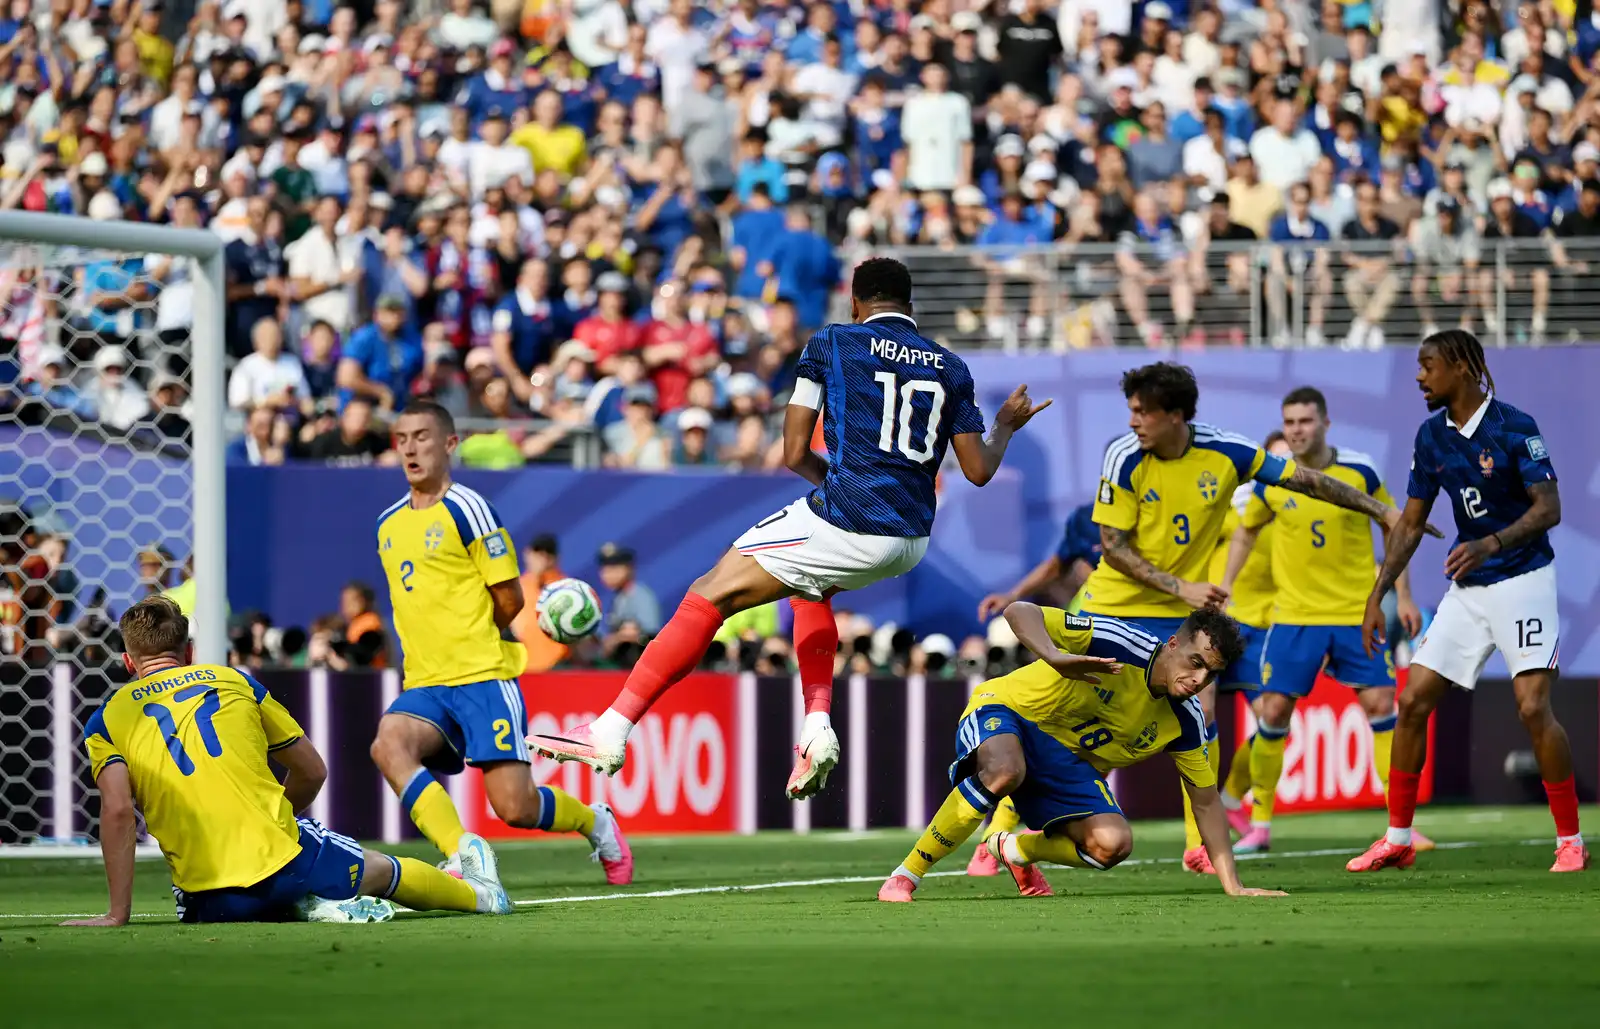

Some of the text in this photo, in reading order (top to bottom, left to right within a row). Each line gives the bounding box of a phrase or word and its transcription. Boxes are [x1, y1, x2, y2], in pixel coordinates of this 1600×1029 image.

[870, 337, 944, 369] MBAPPE
[874, 371, 947, 464] 10
[1460, 486, 1488, 519] 12
[1172, 513, 1190, 545] 3
[1311, 520, 1326, 549] 5
[400, 560, 414, 592] 2
[1515, 618, 1543, 648] 12
[131, 669, 217, 701] GYÖKERES
[142, 684, 223, 777] 17
[492, 718, 512, 751] 2
[1071, 716, 1114, 751] 18
